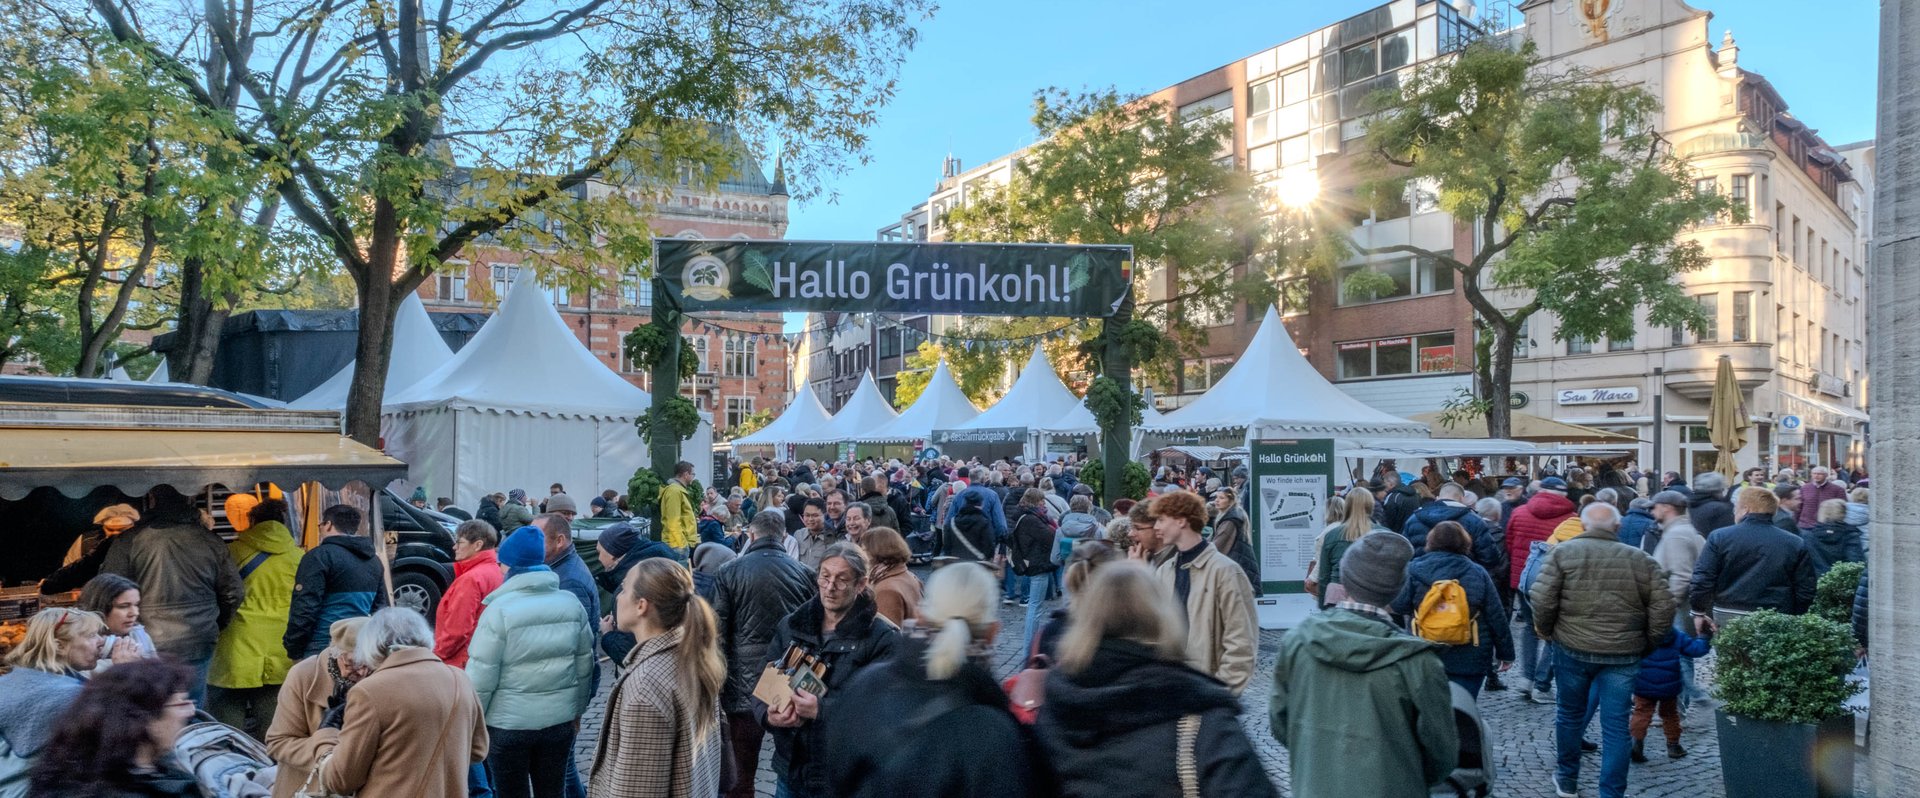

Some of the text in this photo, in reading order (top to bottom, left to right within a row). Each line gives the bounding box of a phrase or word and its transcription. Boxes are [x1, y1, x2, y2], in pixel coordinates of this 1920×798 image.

[773, 259, 1071, 303] Hallo Grünkohl!
[1561, 389, 1633, 402] San Marco
[1259, 453, 1327, 463] Hallo Grünkohl
